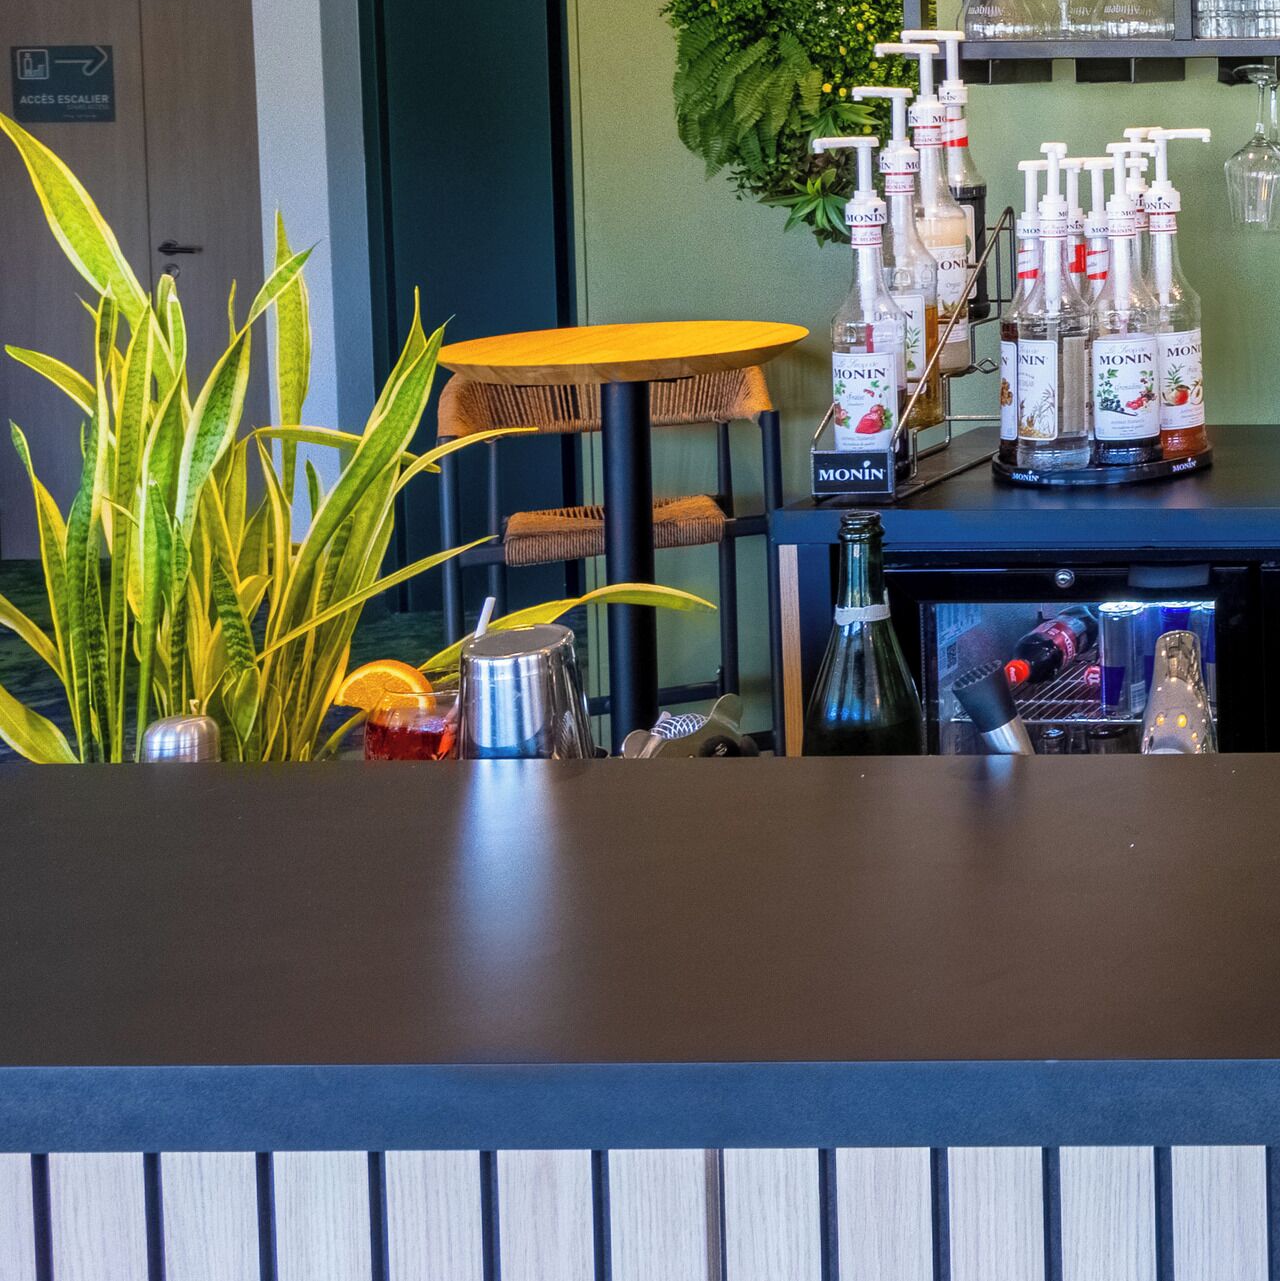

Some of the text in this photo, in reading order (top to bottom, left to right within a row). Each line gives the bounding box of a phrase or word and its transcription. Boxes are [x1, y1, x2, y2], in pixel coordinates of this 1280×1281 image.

[19, 93, 110, 104] ACCÈS ESCALIER
[846, 207, 886, 224] MONIN
[1099, 353, 1152, 365] MONIN
[833, 363, 887, 380] MONIN
[819, 459, 885, 482] MONIN
[1172, 458, 1197, 472] MONIN
[1012, 470, 1040, 481] MONIN
